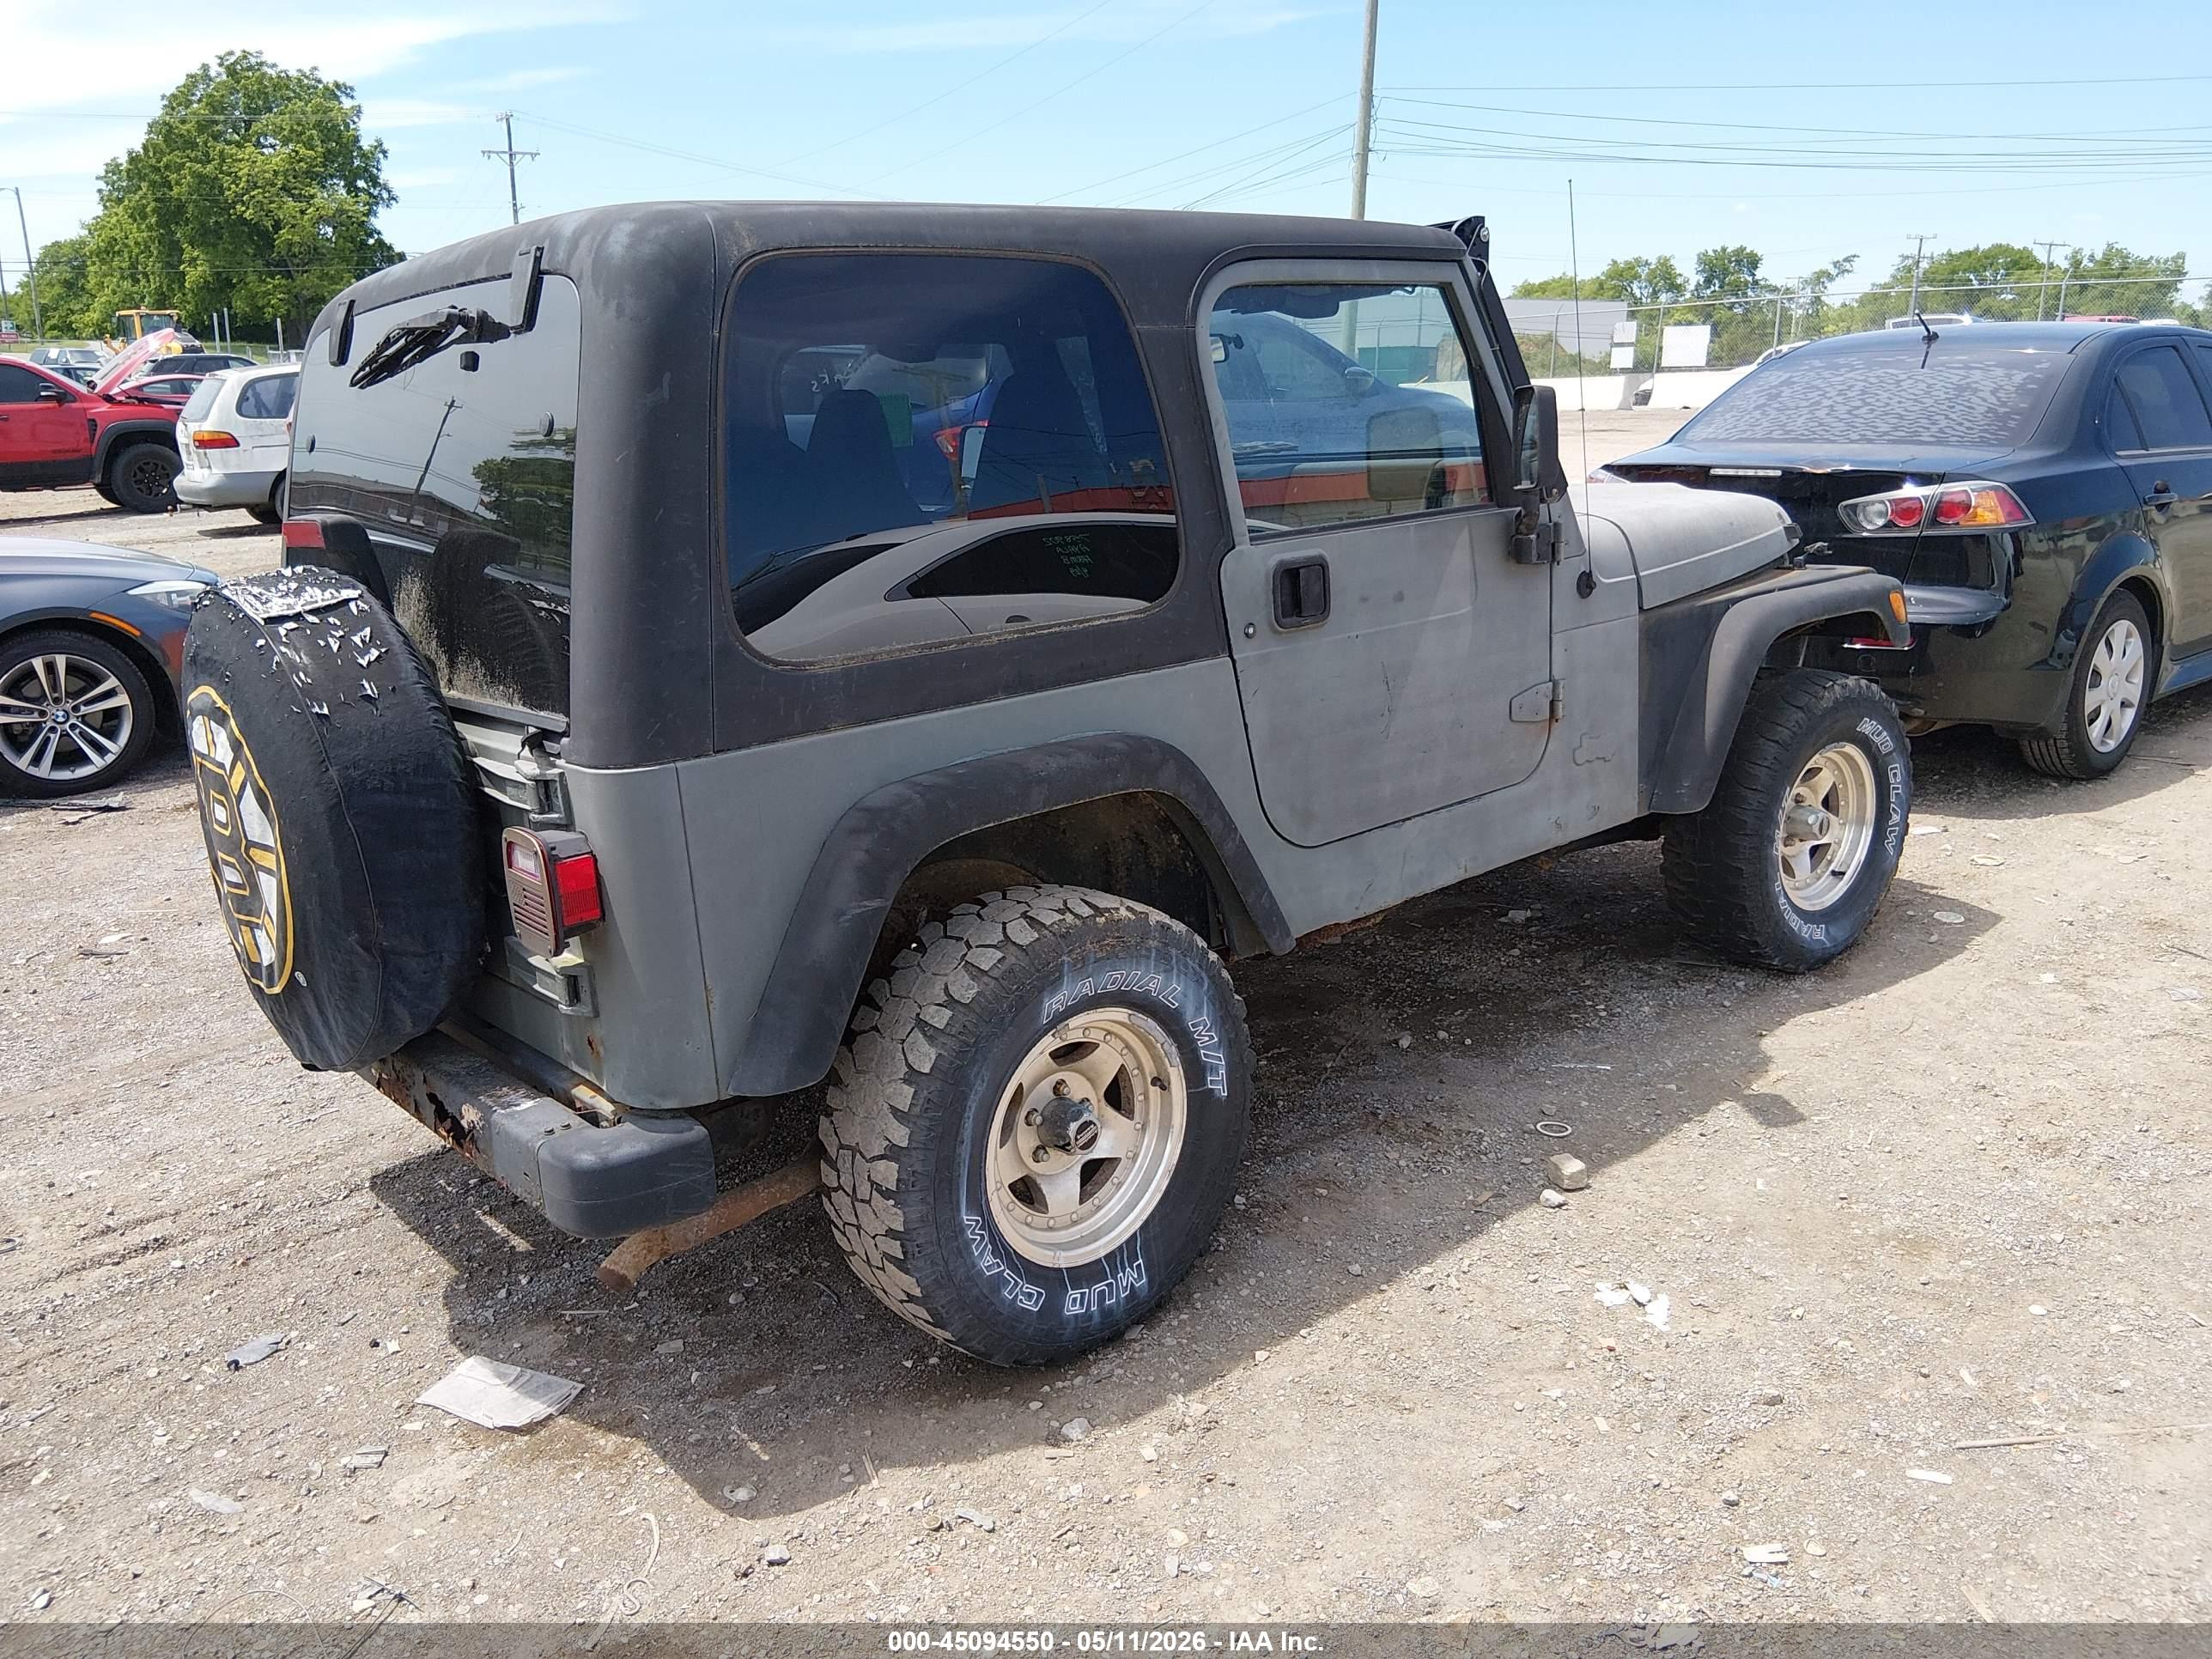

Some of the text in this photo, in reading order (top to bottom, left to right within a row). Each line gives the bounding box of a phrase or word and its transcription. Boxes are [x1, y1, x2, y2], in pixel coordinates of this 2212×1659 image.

[1856, 717, 1903, 856] MUD CLAW
[1042, 969, 1228, 1097] RADIAL M/T
[964, 1214, 1146, 1316] MUD CLAW
